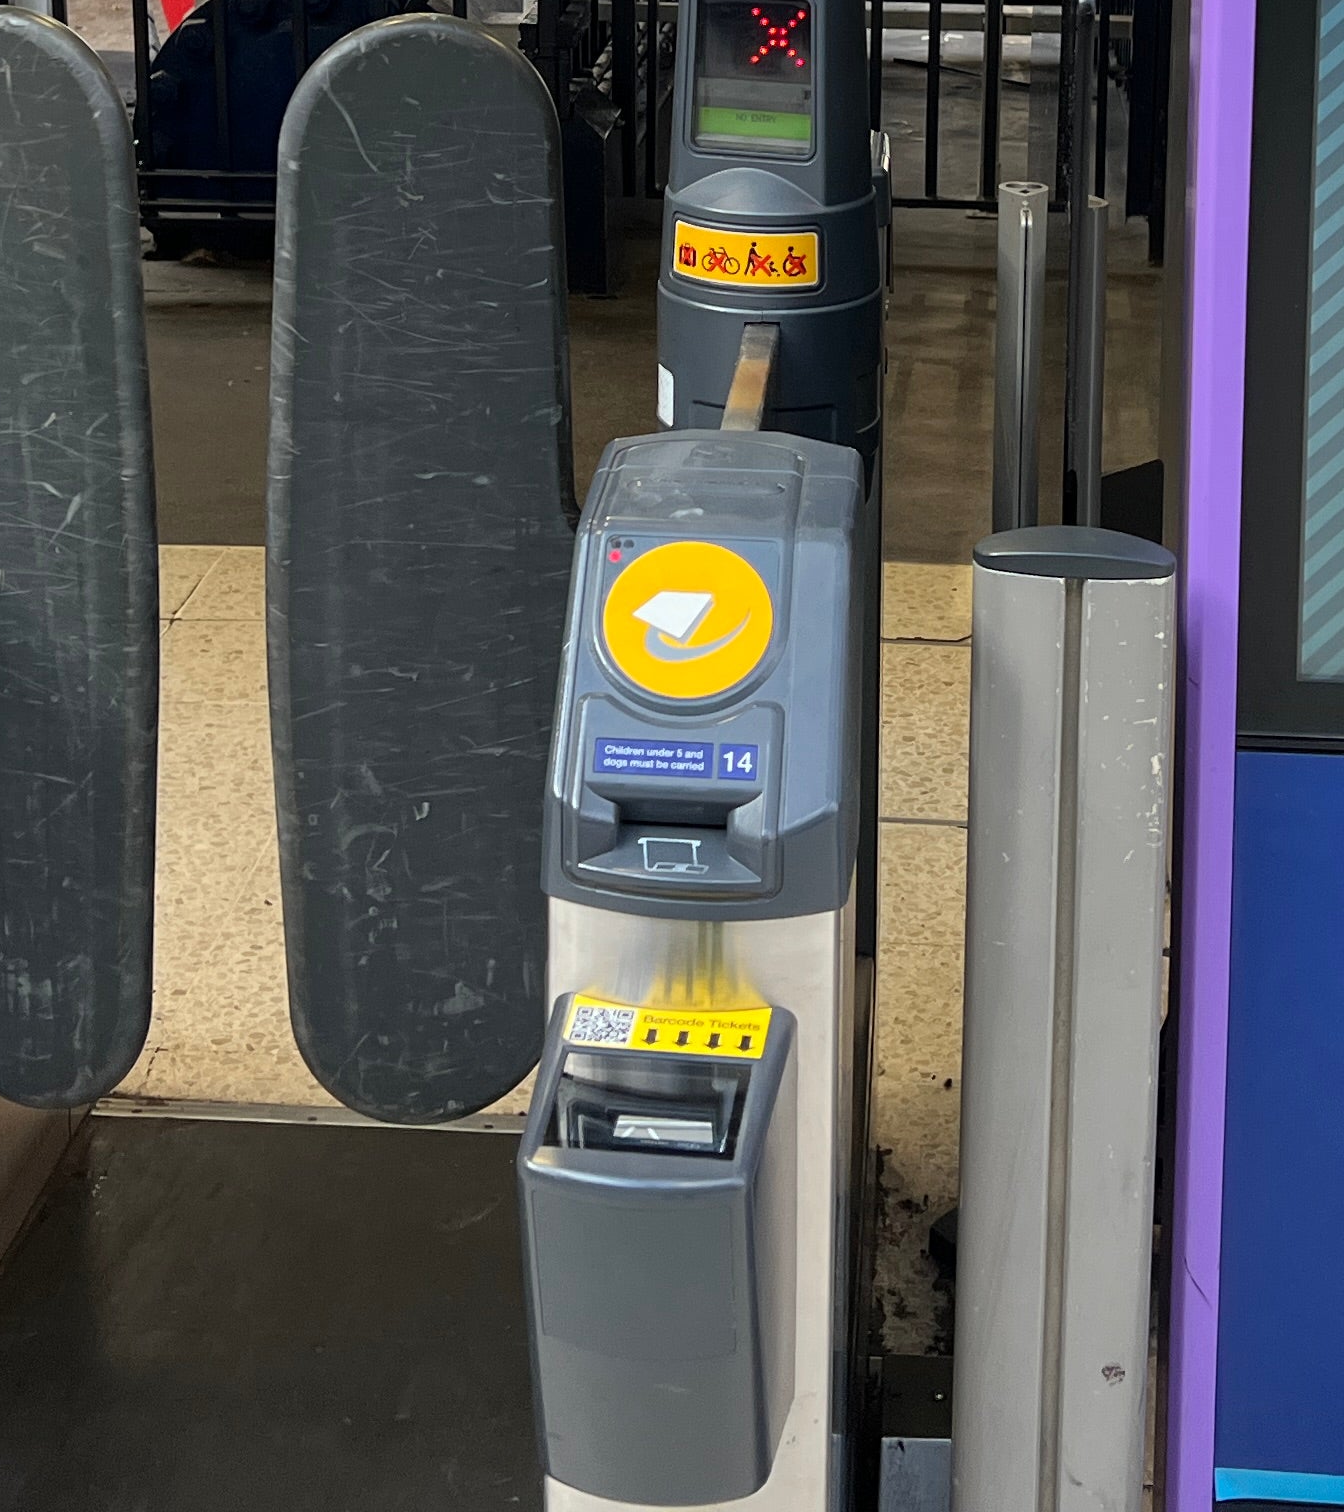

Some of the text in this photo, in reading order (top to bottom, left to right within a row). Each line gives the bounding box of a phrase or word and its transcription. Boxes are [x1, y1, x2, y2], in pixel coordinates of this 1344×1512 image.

[604, 744, 704, 760] Children under 5 and
[603, 758, 705, 771] dogs must be carried
[723, 751, 753, 773] 14
[643, 1015, 761, 1032] Barcode Tickets
